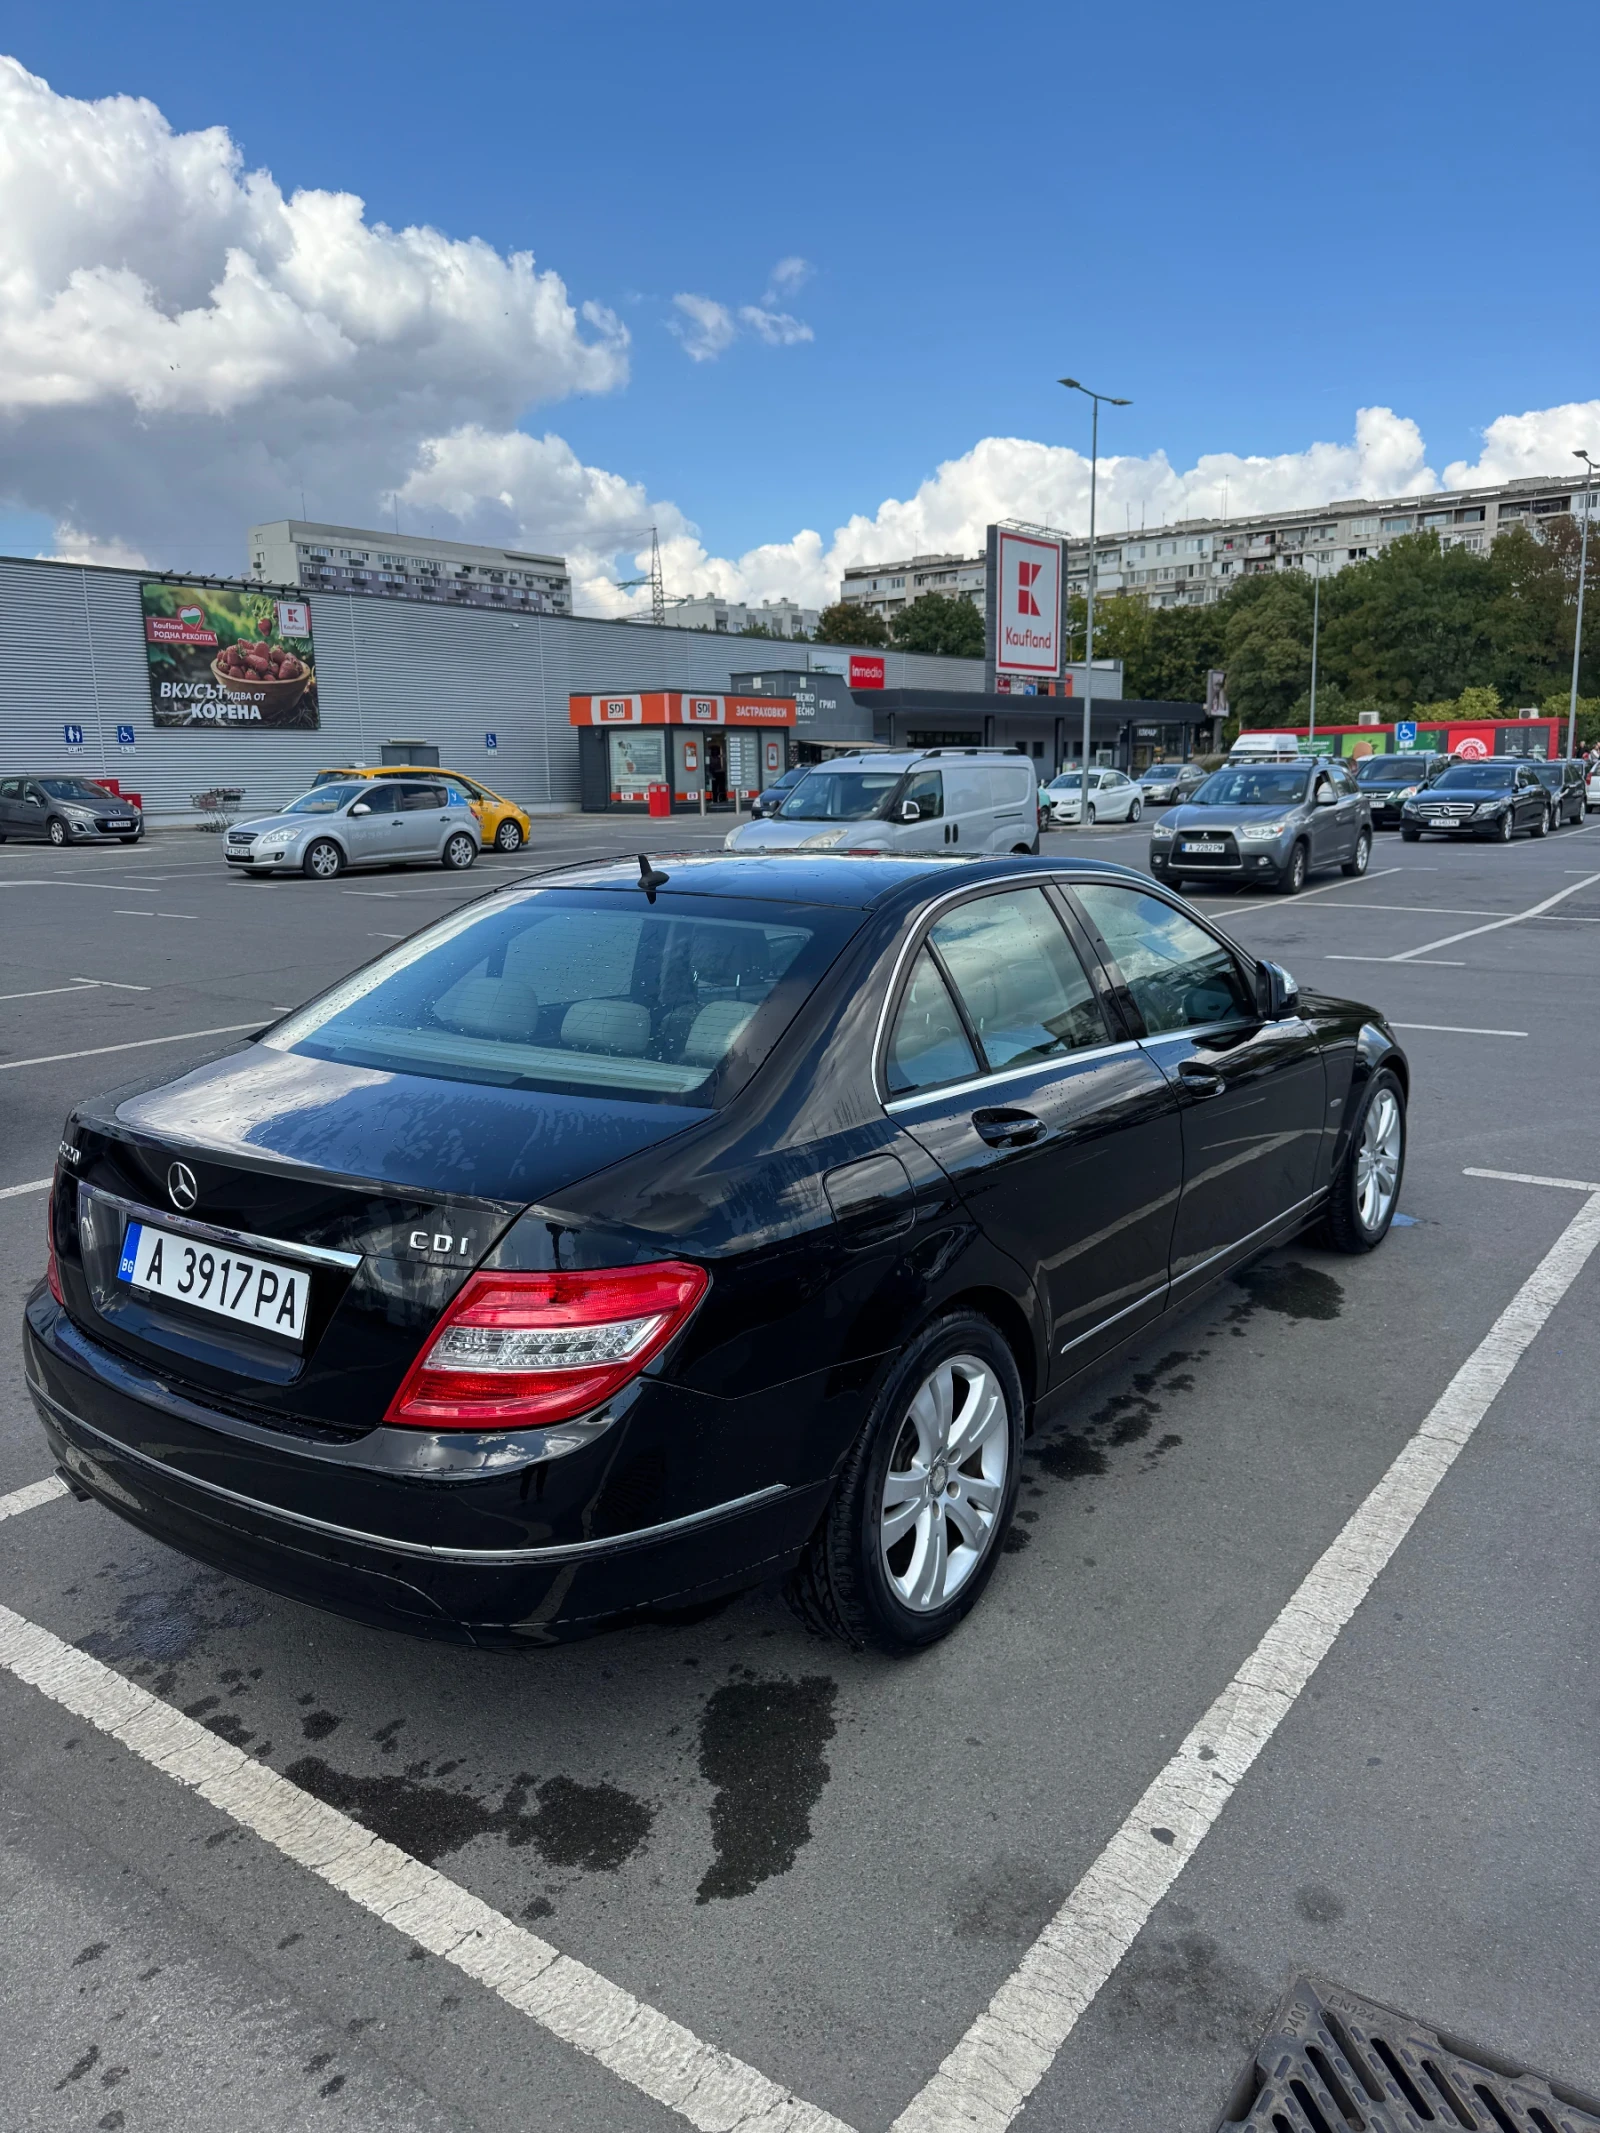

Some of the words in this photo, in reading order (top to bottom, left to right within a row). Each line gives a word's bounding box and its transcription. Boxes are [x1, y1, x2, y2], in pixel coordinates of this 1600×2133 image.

[153, 622, 183, 630] Kaufland
[154, 631, 180, 639] РОДНА
[182, 633, 213, 641] РЕКОЛТА
[1005, 627, 1051, 649] Kaufland
[852, 664, 883, 678] inmedio
[160, 682, 227, 699] ВКУСЪТ
[227, 692, 252, 701] ИДВА
[253, 693, 266, 701] ОТ
[191, 703, 262, 719] КОРЕНА
[609, 703, 624, 714] SDI
[697, 703, 710, 714] SDI
[819, 700, 836, 709] ГРИЛ
[736, 706, 787, 718] ЗАСТРАХОВКИ
[409, 1231, 469, 1255] CDI
[121, 1258, 134, 1273] BG
[146, 1238, 164, 1285] A
[177, 1247, 295, 1329] 3917PA
[1281, 2002, 1311, 2037] D400
